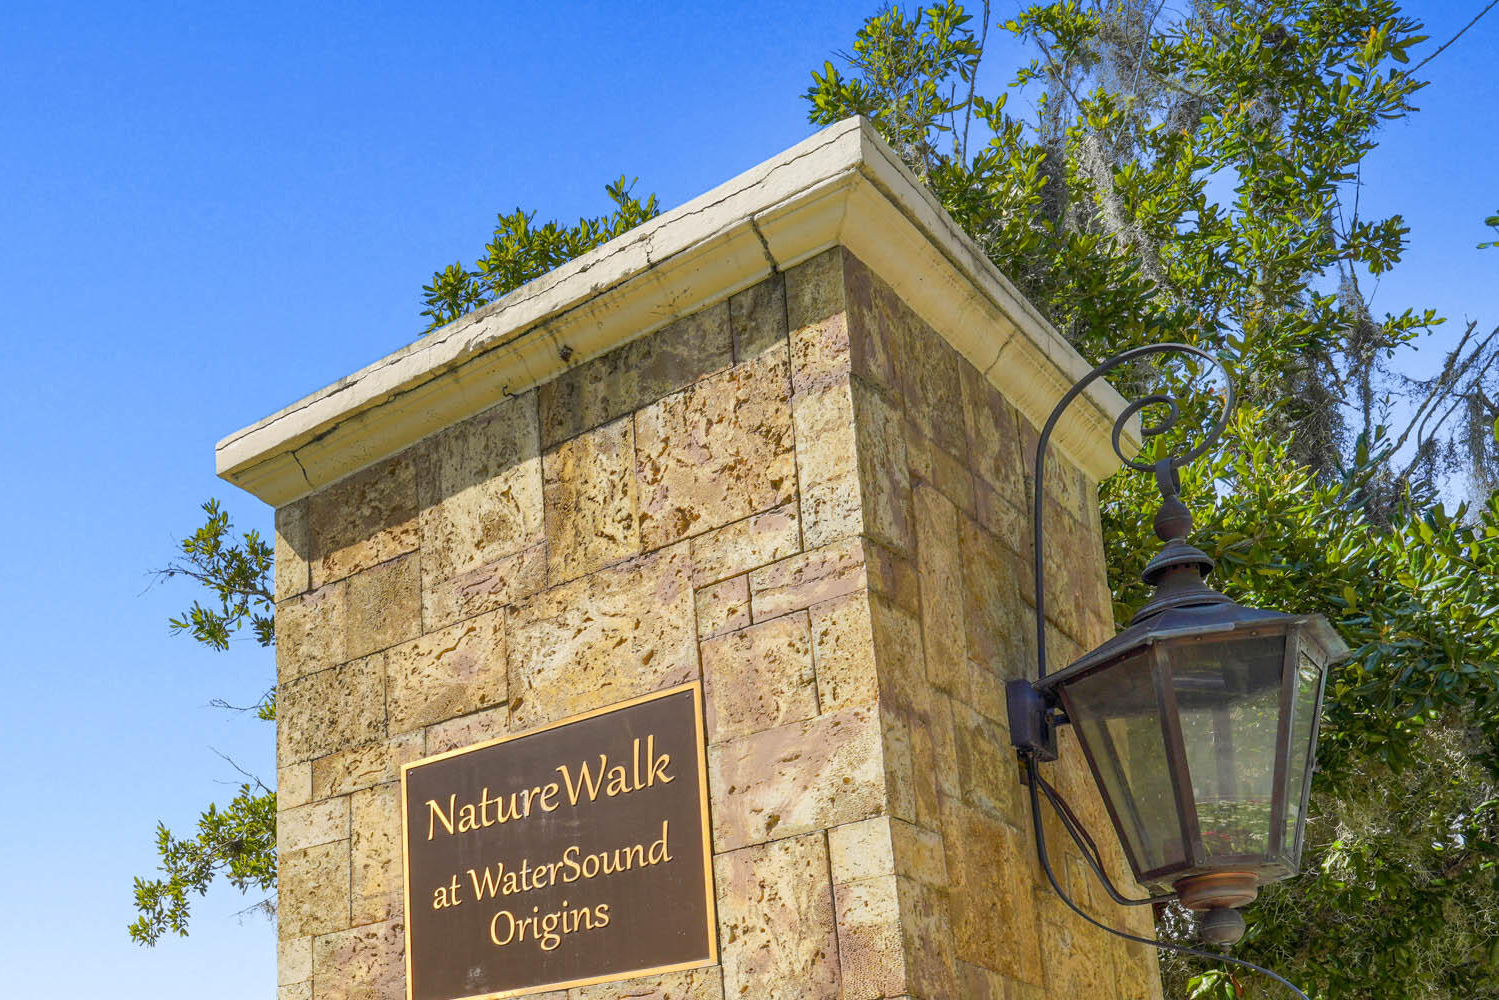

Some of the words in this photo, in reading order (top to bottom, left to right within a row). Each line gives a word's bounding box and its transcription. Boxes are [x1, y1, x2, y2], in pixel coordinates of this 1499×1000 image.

[425, 735, 675, 840] NatureWalk
[433, 875, 462, 910] at
[467, 820, 673, 901] WaterSound
[490, 901, 610, 950] Origins
